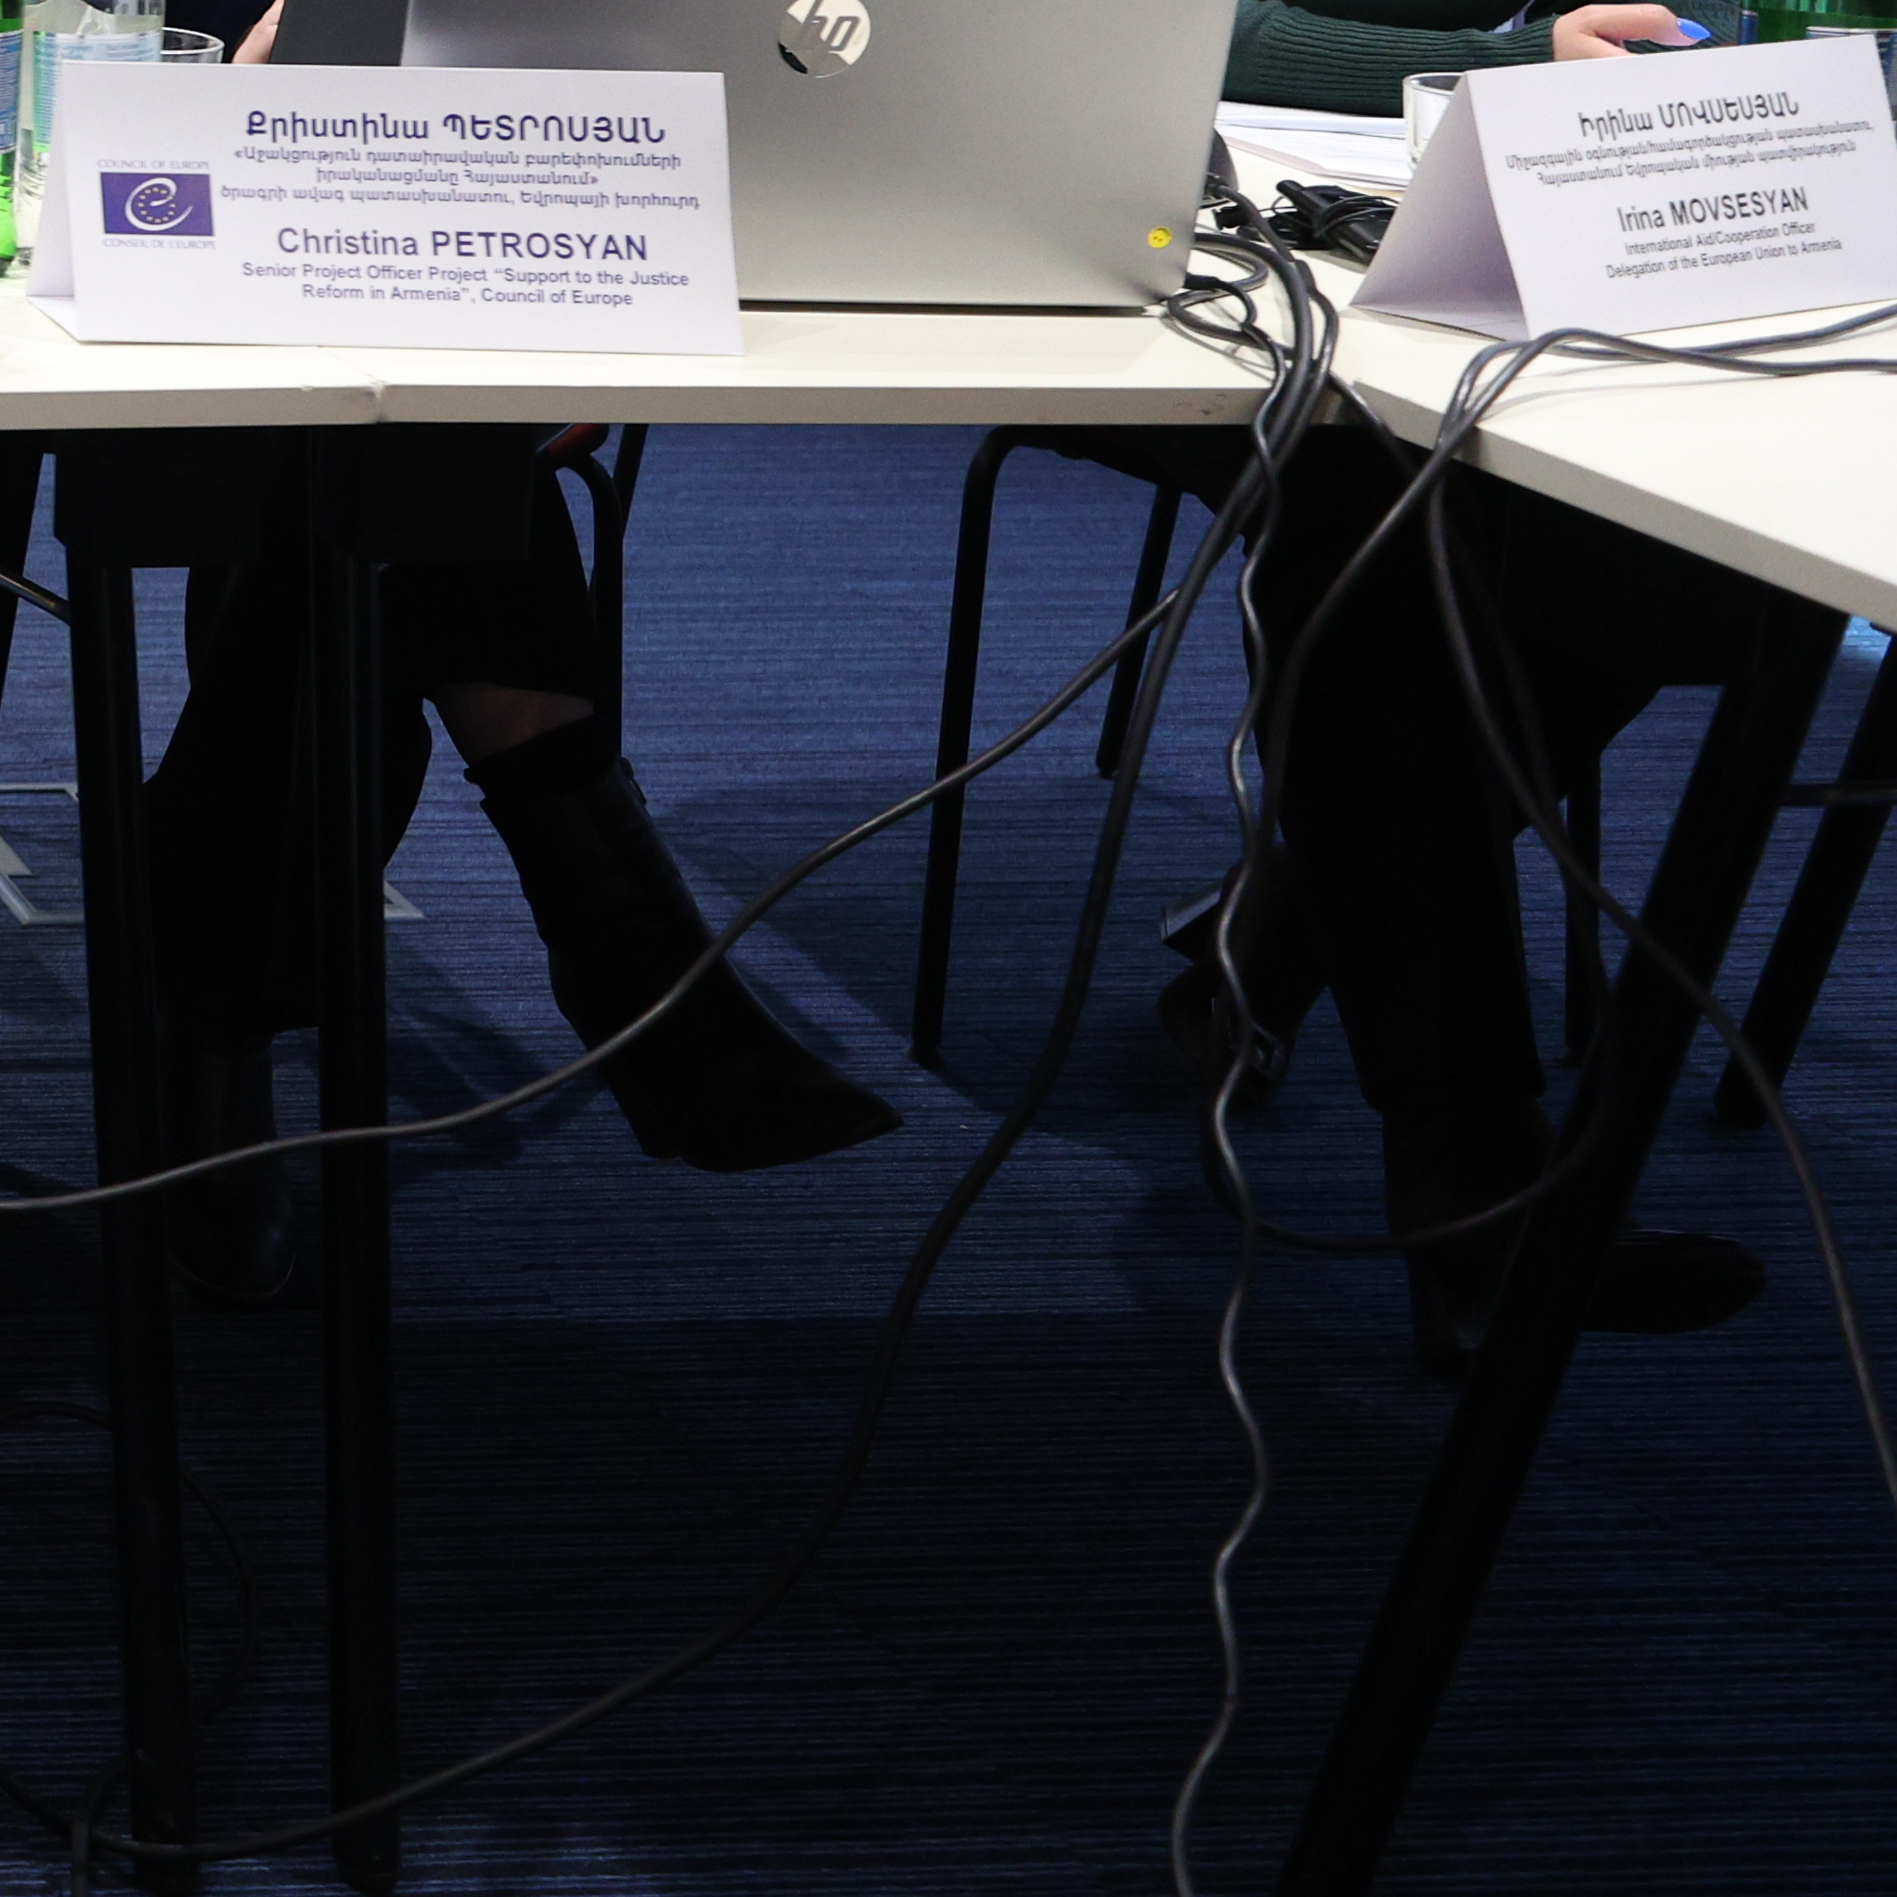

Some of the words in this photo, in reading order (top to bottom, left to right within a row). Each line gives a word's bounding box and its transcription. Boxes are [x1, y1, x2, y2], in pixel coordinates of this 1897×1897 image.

[246, 110, 429, 145] Քրիստինա
[442, 113, 666, 144] ՊԵՏՐՈՍՅԱՆ
[1578, 108, 1654, 142] Իրինա
[1658, 91, 1800, 128] ՄՈՎՍԵՍՅԱՆ
[1617, 206, 1666, 232] Irina
[1668, 186, 1810, 226] MOVSESYAN
[277, 227, 419, 256] Christina
[431, 230, 648, 261] PETROSYAN
[1625, 236, 1693, 256] International
[1782, 221, 1816, 237] Officer
[242, 262, 297, 278] Senior
[302, 263, 361, 283] Project
[366, 264, 424, 281] Officer
[428, 266, 488, 285] Project
[576, 269, 592, 284] to
[597, 269, 624, 285] the
[629, 270, 689, 287] Justice
[1606, 258, 1665, 279] Delegation
[1668, 257, 1679, 271] of
[1681, 255, 1698, 270] the
[1701, 250, 1753, 267] European
[1755, 245, 1786, 261] Union
[1788, 245, 1798, 256] to
[1801, 237, 1843, 255] Armenia
[302, 284, 365, 300] Reform
[370, 285, 385, 300] in
[481, 288, 545, 303] Council
[550, 289, 567, 304] of
[572, 290, 633, 307] Europe
